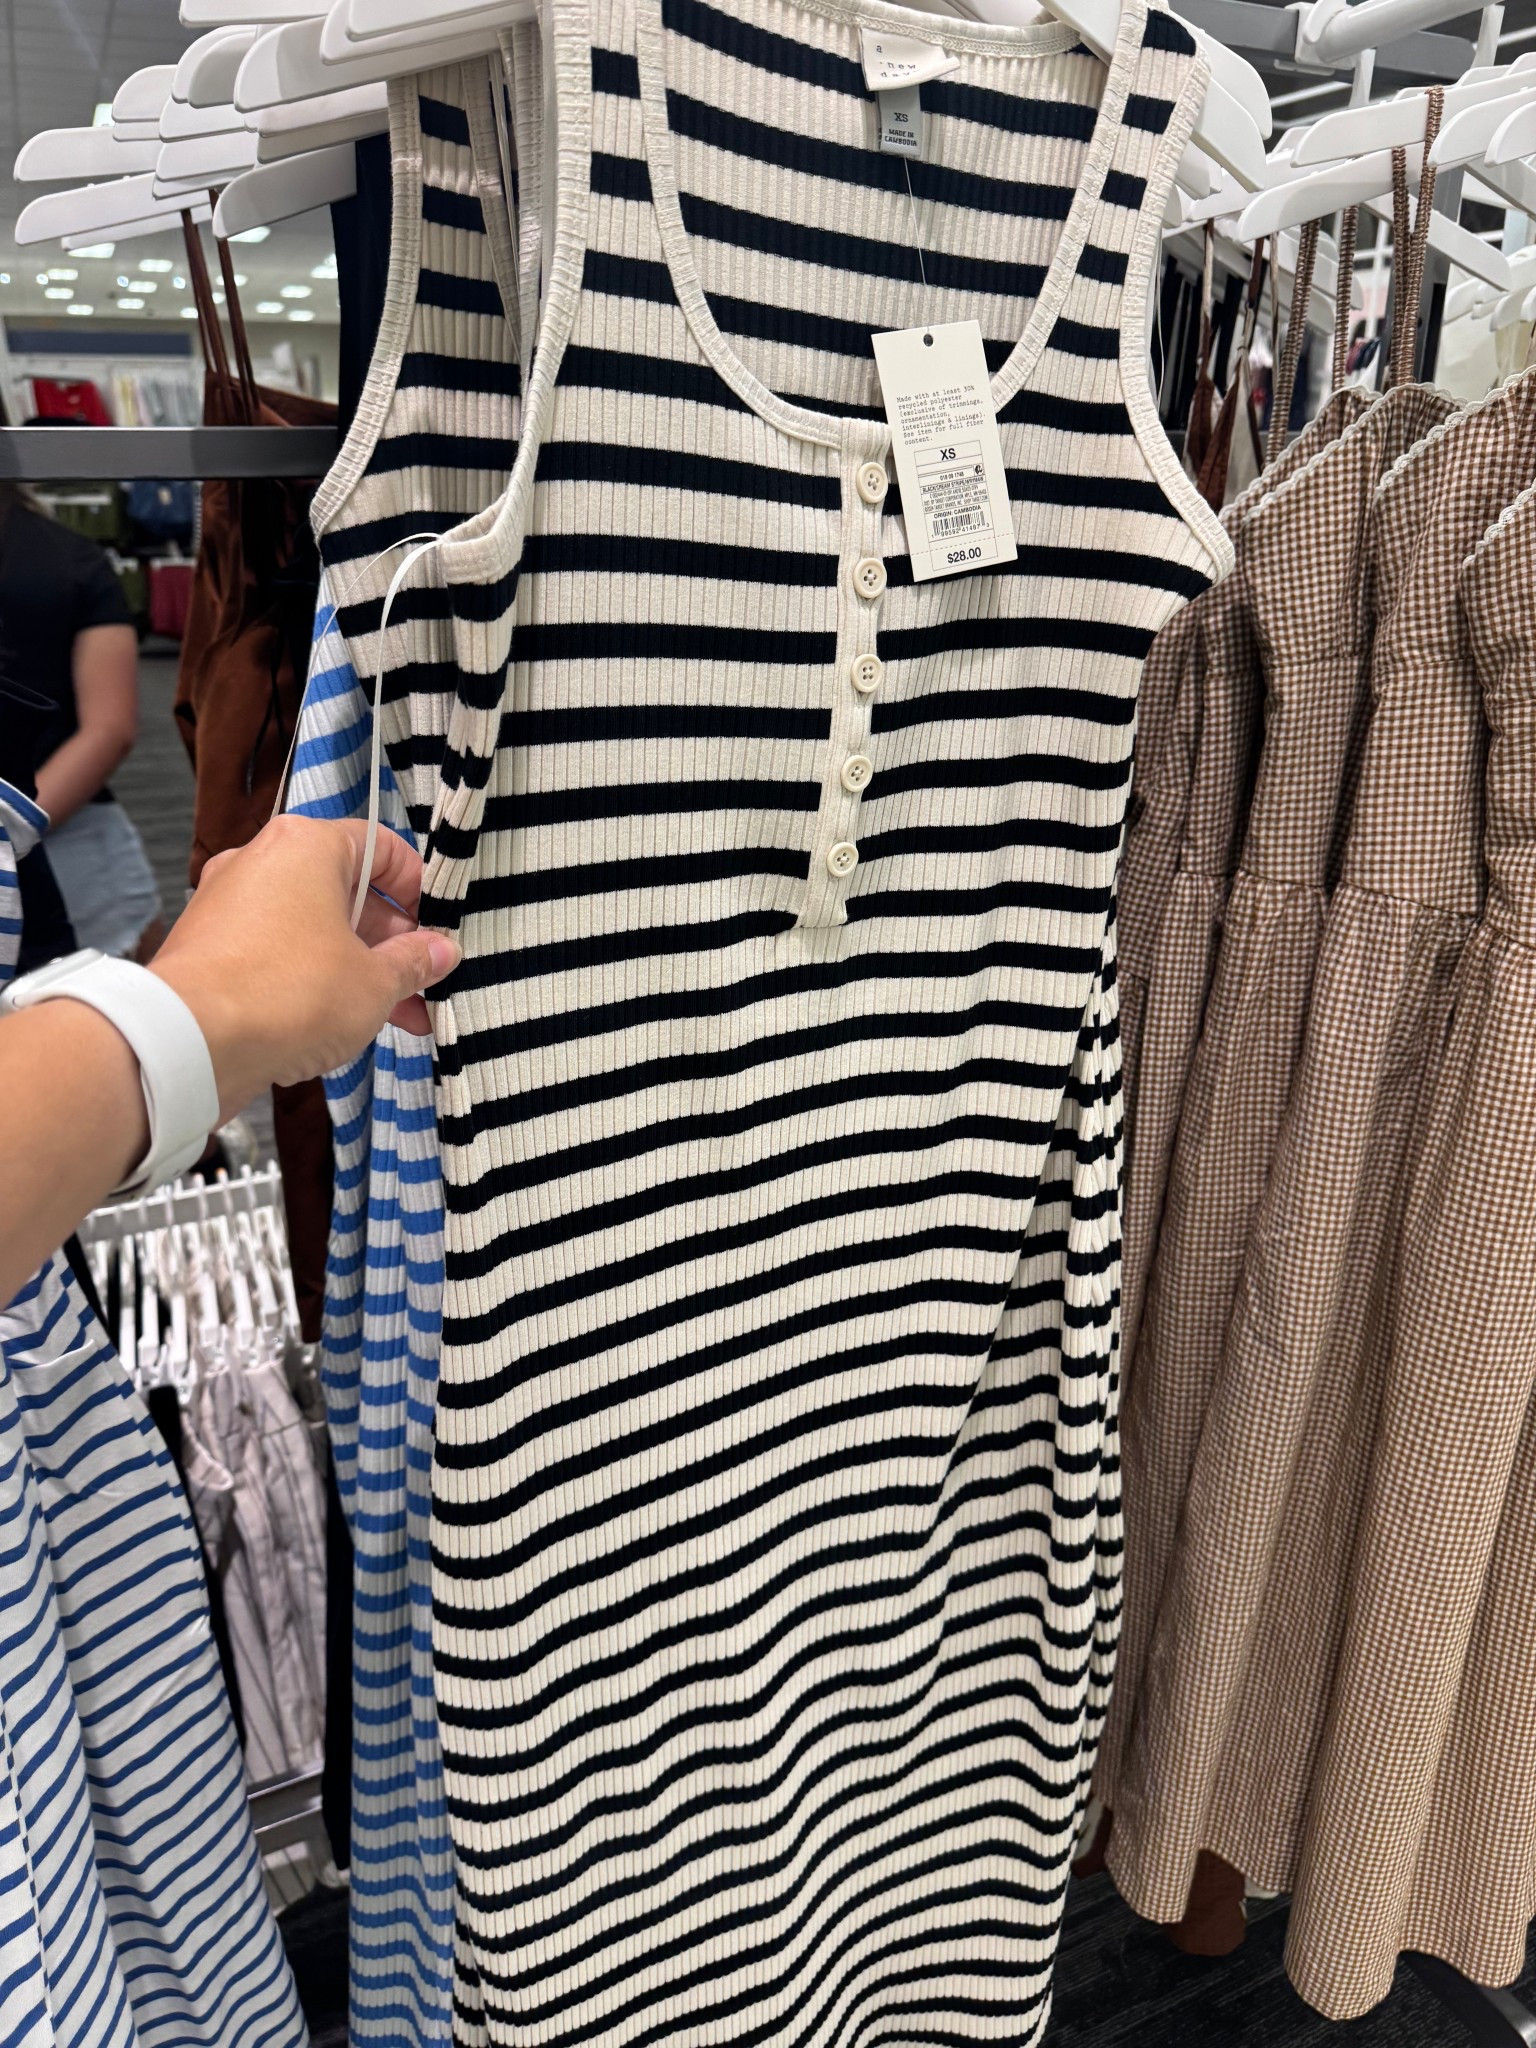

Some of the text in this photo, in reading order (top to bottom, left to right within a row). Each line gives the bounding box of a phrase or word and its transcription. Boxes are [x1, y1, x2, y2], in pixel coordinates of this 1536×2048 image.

[876, 45, 882, 53] a
[894, 112, 908, 122] XS
[889, 129, 906, 137] MADE
[884, 136, 917, 146] CAMBODIA
[943, 388, 960, 396] least
[898, 395, 962, 410] recycled polyester
[900, 406, 936, 417] (exclusive
[949, 399, 984, 408] trimmings,
[901, 412, 950, 424] ornamentation,
[902, 420, 944, 431] interlinings
[955, 412, 986, 422] linings).
[904, 436, 932, 446] content.
[940, 448, 956, 461] XS
[934, 504, 982, 518] ORIGIN: CAMBODIA
[947, 546, 982, 564] $28.00
